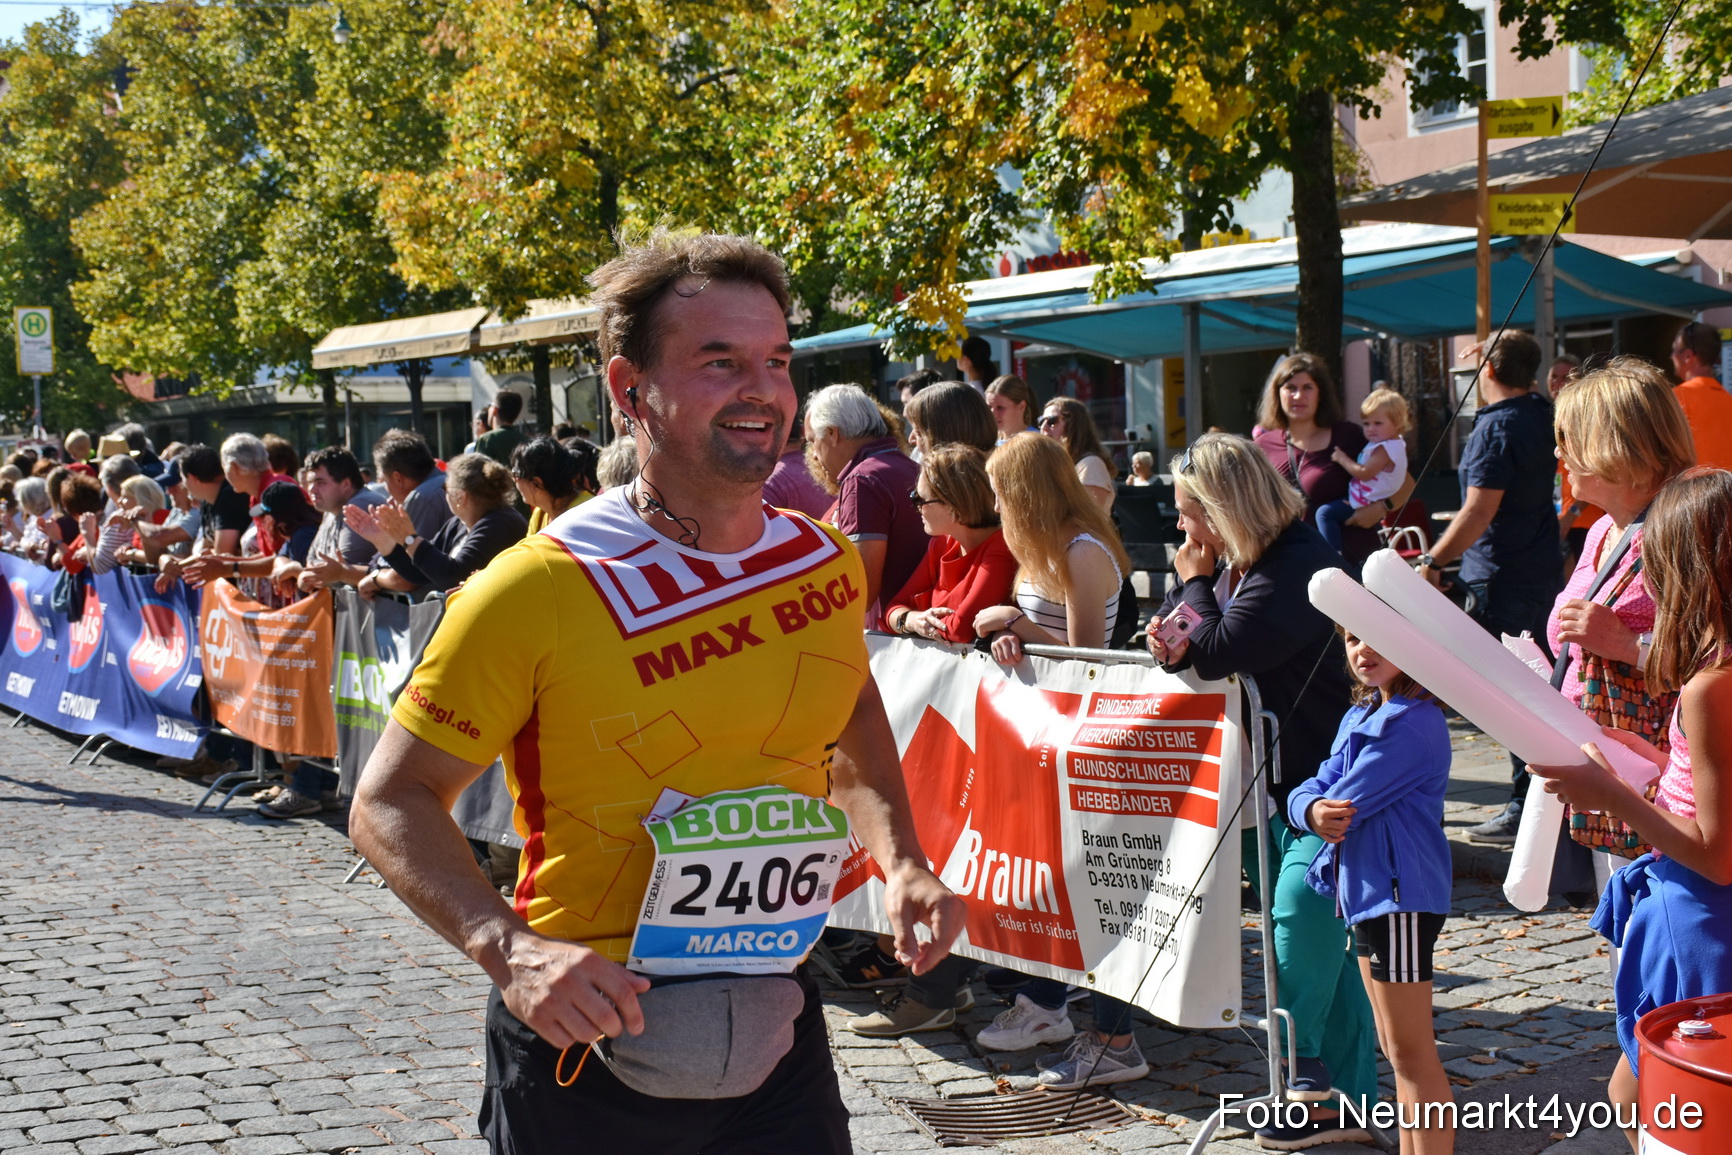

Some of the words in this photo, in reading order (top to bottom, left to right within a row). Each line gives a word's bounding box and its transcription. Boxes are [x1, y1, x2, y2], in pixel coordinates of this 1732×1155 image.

[1488, 105, 1548, 118] tartnummern-
[1498, 120, 1534, 135] ausgabe
[1508, 215, 1545, 229] ausgabe
[632, 614, 766, 688] MAX
[771, 572, 860, 636] BÖGL
[337, 711, 374, 731] nspired
[1078, 727, 1198, 748] VERZURRSYSTEME
[1073, 758, 1191, 782] RUNDSCHLINGEN
[959, 790, 969, 808] Seit
[966, 768, 976, 790] 1929
[1077, 790, 1173, 813] HEBEBÄNDER
[671, 797, 832, 843] BOCK
[1082, 829, 1119, 848] Braun
[1122, 832, 1162, 851] GmbH
[956, 828, 1060, 915] Braun
[1085, 851, 1105, 868] Am
[1108, 852, 1164, 877] Grünberg
[1166, 858, 1171, 875] 8
[669, 853, 827, 916] 2406
[1088, 870, 1138, 890] D-92318
[1094, 898, 1118, 916] Tel.
[1121, 901, 1148, 922] 09181
[995, 912, 1027, 933] Sicher
[1029, 919, 1044, 935] ist
[1046, 922, 1079, 941] sicher
[1099, 918, 1121, 936] Fax
[1123, 921, 1147, 944] 09181
[685, 929, 799, 954] MARCO
